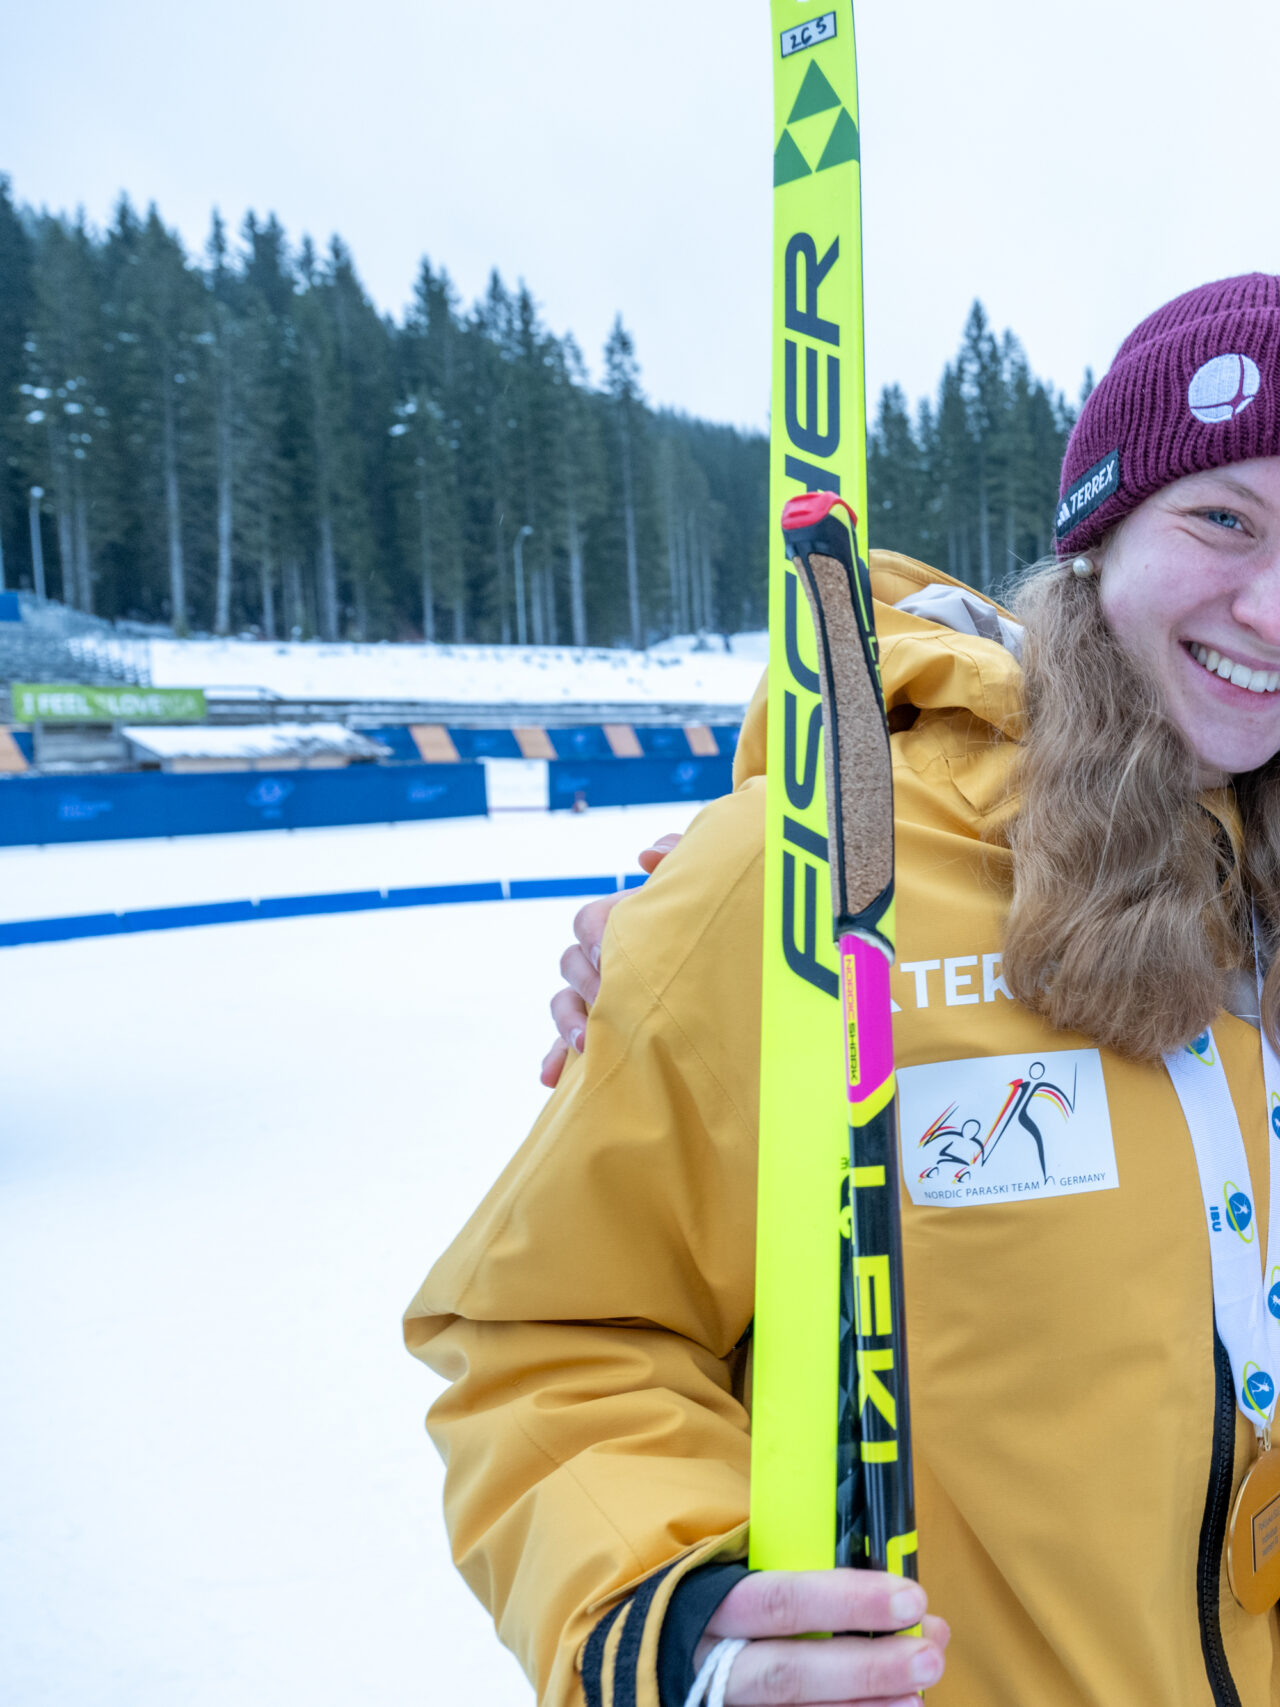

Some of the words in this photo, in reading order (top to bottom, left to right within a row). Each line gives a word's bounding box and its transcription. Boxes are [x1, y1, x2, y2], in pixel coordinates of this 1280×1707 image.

[1069, 459, 1116, 515] TERREX
[848, 1021, 858, 1082] SHARK
[923, 1188, 963, 1200] NORDIC
[965, 1184, 1009, 1198] PARASKI
[1012, 1181, 1041, 1193] TEAM
[1059, 1172, 1107, 1187] GERMANY
[1209, 1205, 1223, 1233] IBU
[849, 1164, 899, 1464] LEKI
